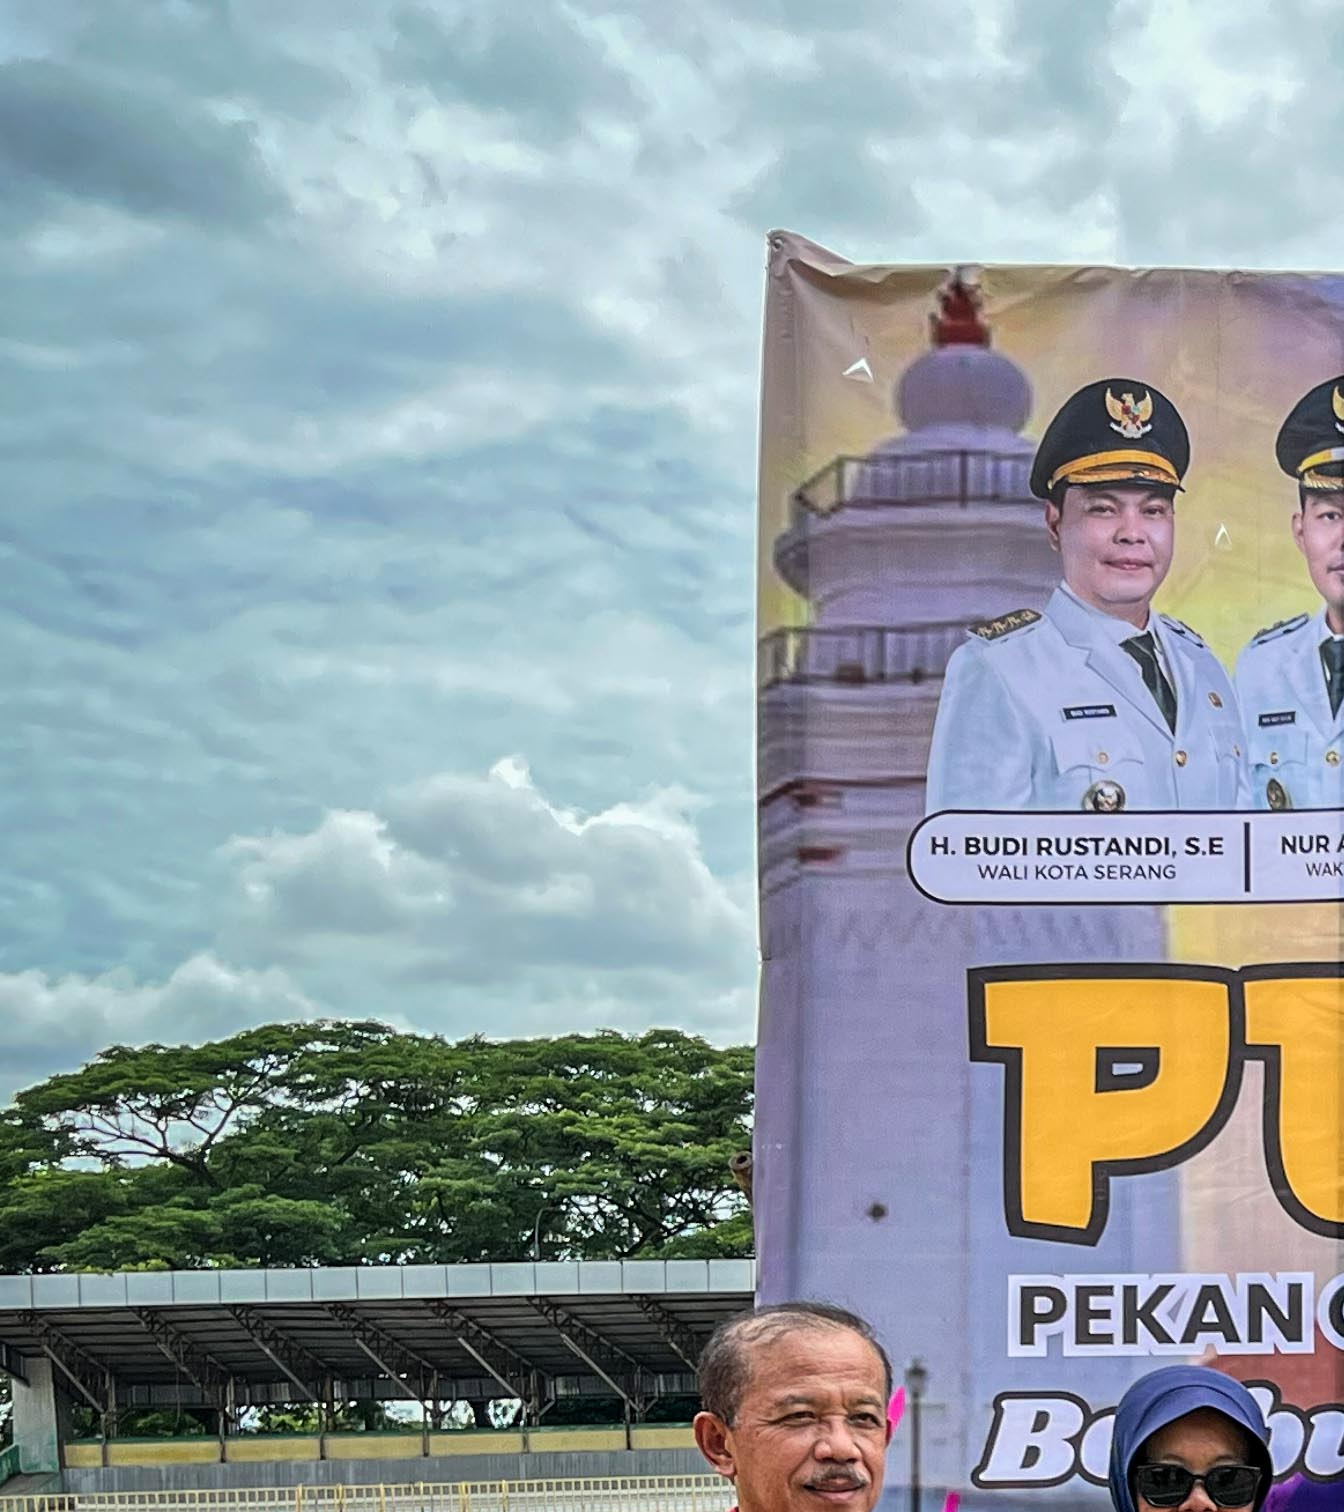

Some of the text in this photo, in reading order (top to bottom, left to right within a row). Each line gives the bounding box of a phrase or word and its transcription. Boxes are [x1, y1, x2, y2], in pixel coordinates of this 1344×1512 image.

[930, 835, 1225, 861] H. BUDI RUSTANDI, S.E
[1281, 834, 1330, 854] NUR
[977, 863, 1177, 881] WALI KOTA SERANG
[1016, 1280, 1305, 1348] PEKAN
